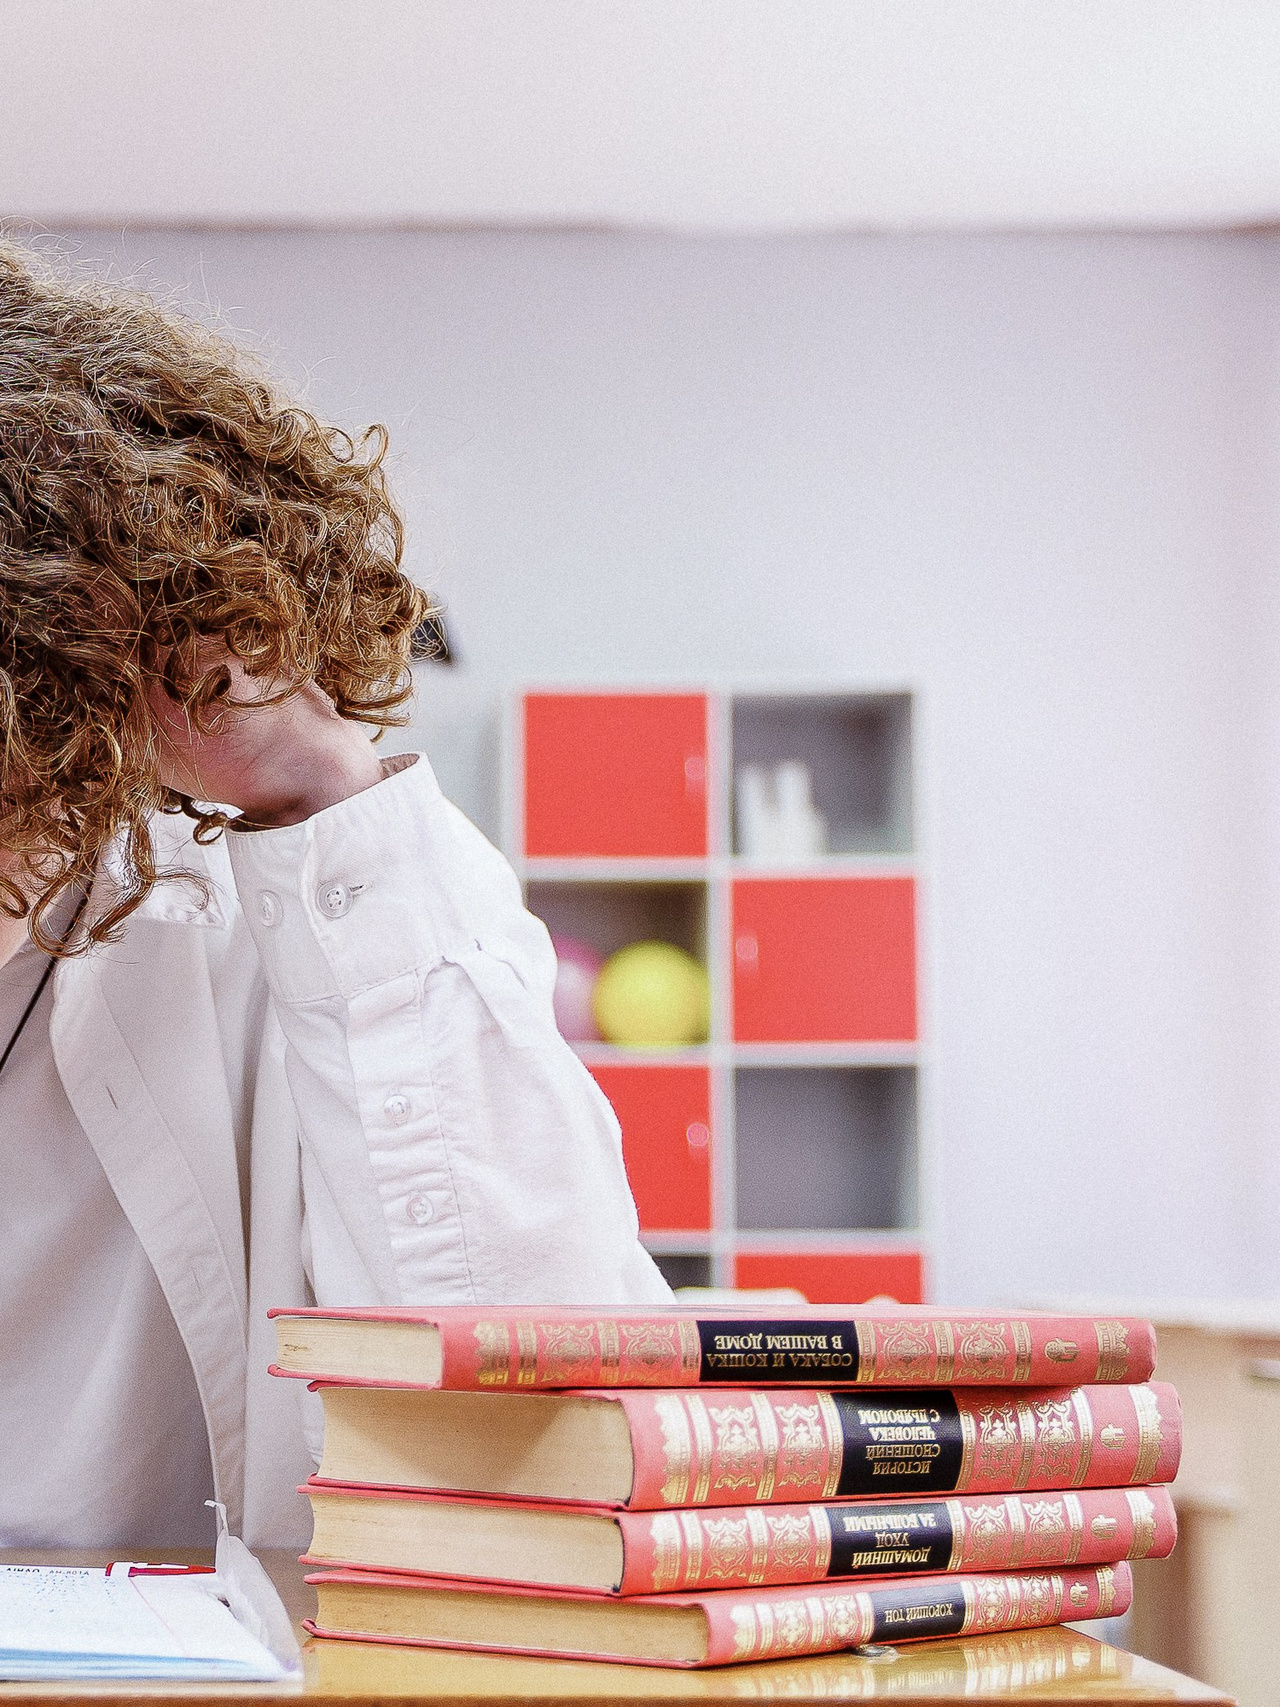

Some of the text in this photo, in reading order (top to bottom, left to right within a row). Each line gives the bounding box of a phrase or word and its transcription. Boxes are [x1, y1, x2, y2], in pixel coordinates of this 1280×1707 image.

[714, 1332, 843, 1350] В ВАШЕМ ДОМЕ
[706, 1353, 853, 1367] СОБАКА И КОШКА
[929, 1409, 940, 1423] С
[868, 1426, 936, 1442] ЧЕЛОВЕКА
[865, 1444, 941, 1460] СНОШЕНИЙ
[872, 1461, 931, 1475] ИСТОРИЯ
[842, 1513, 936, 1532] ЗА БОЛЬНЫМИ
[875, 1531, 909, 1548] УХОД
[851, 1546, 931, 1569] ДОМАШНИЙ
[884, 1603, 953, 1622] ХОРОШИЙ ТОН
